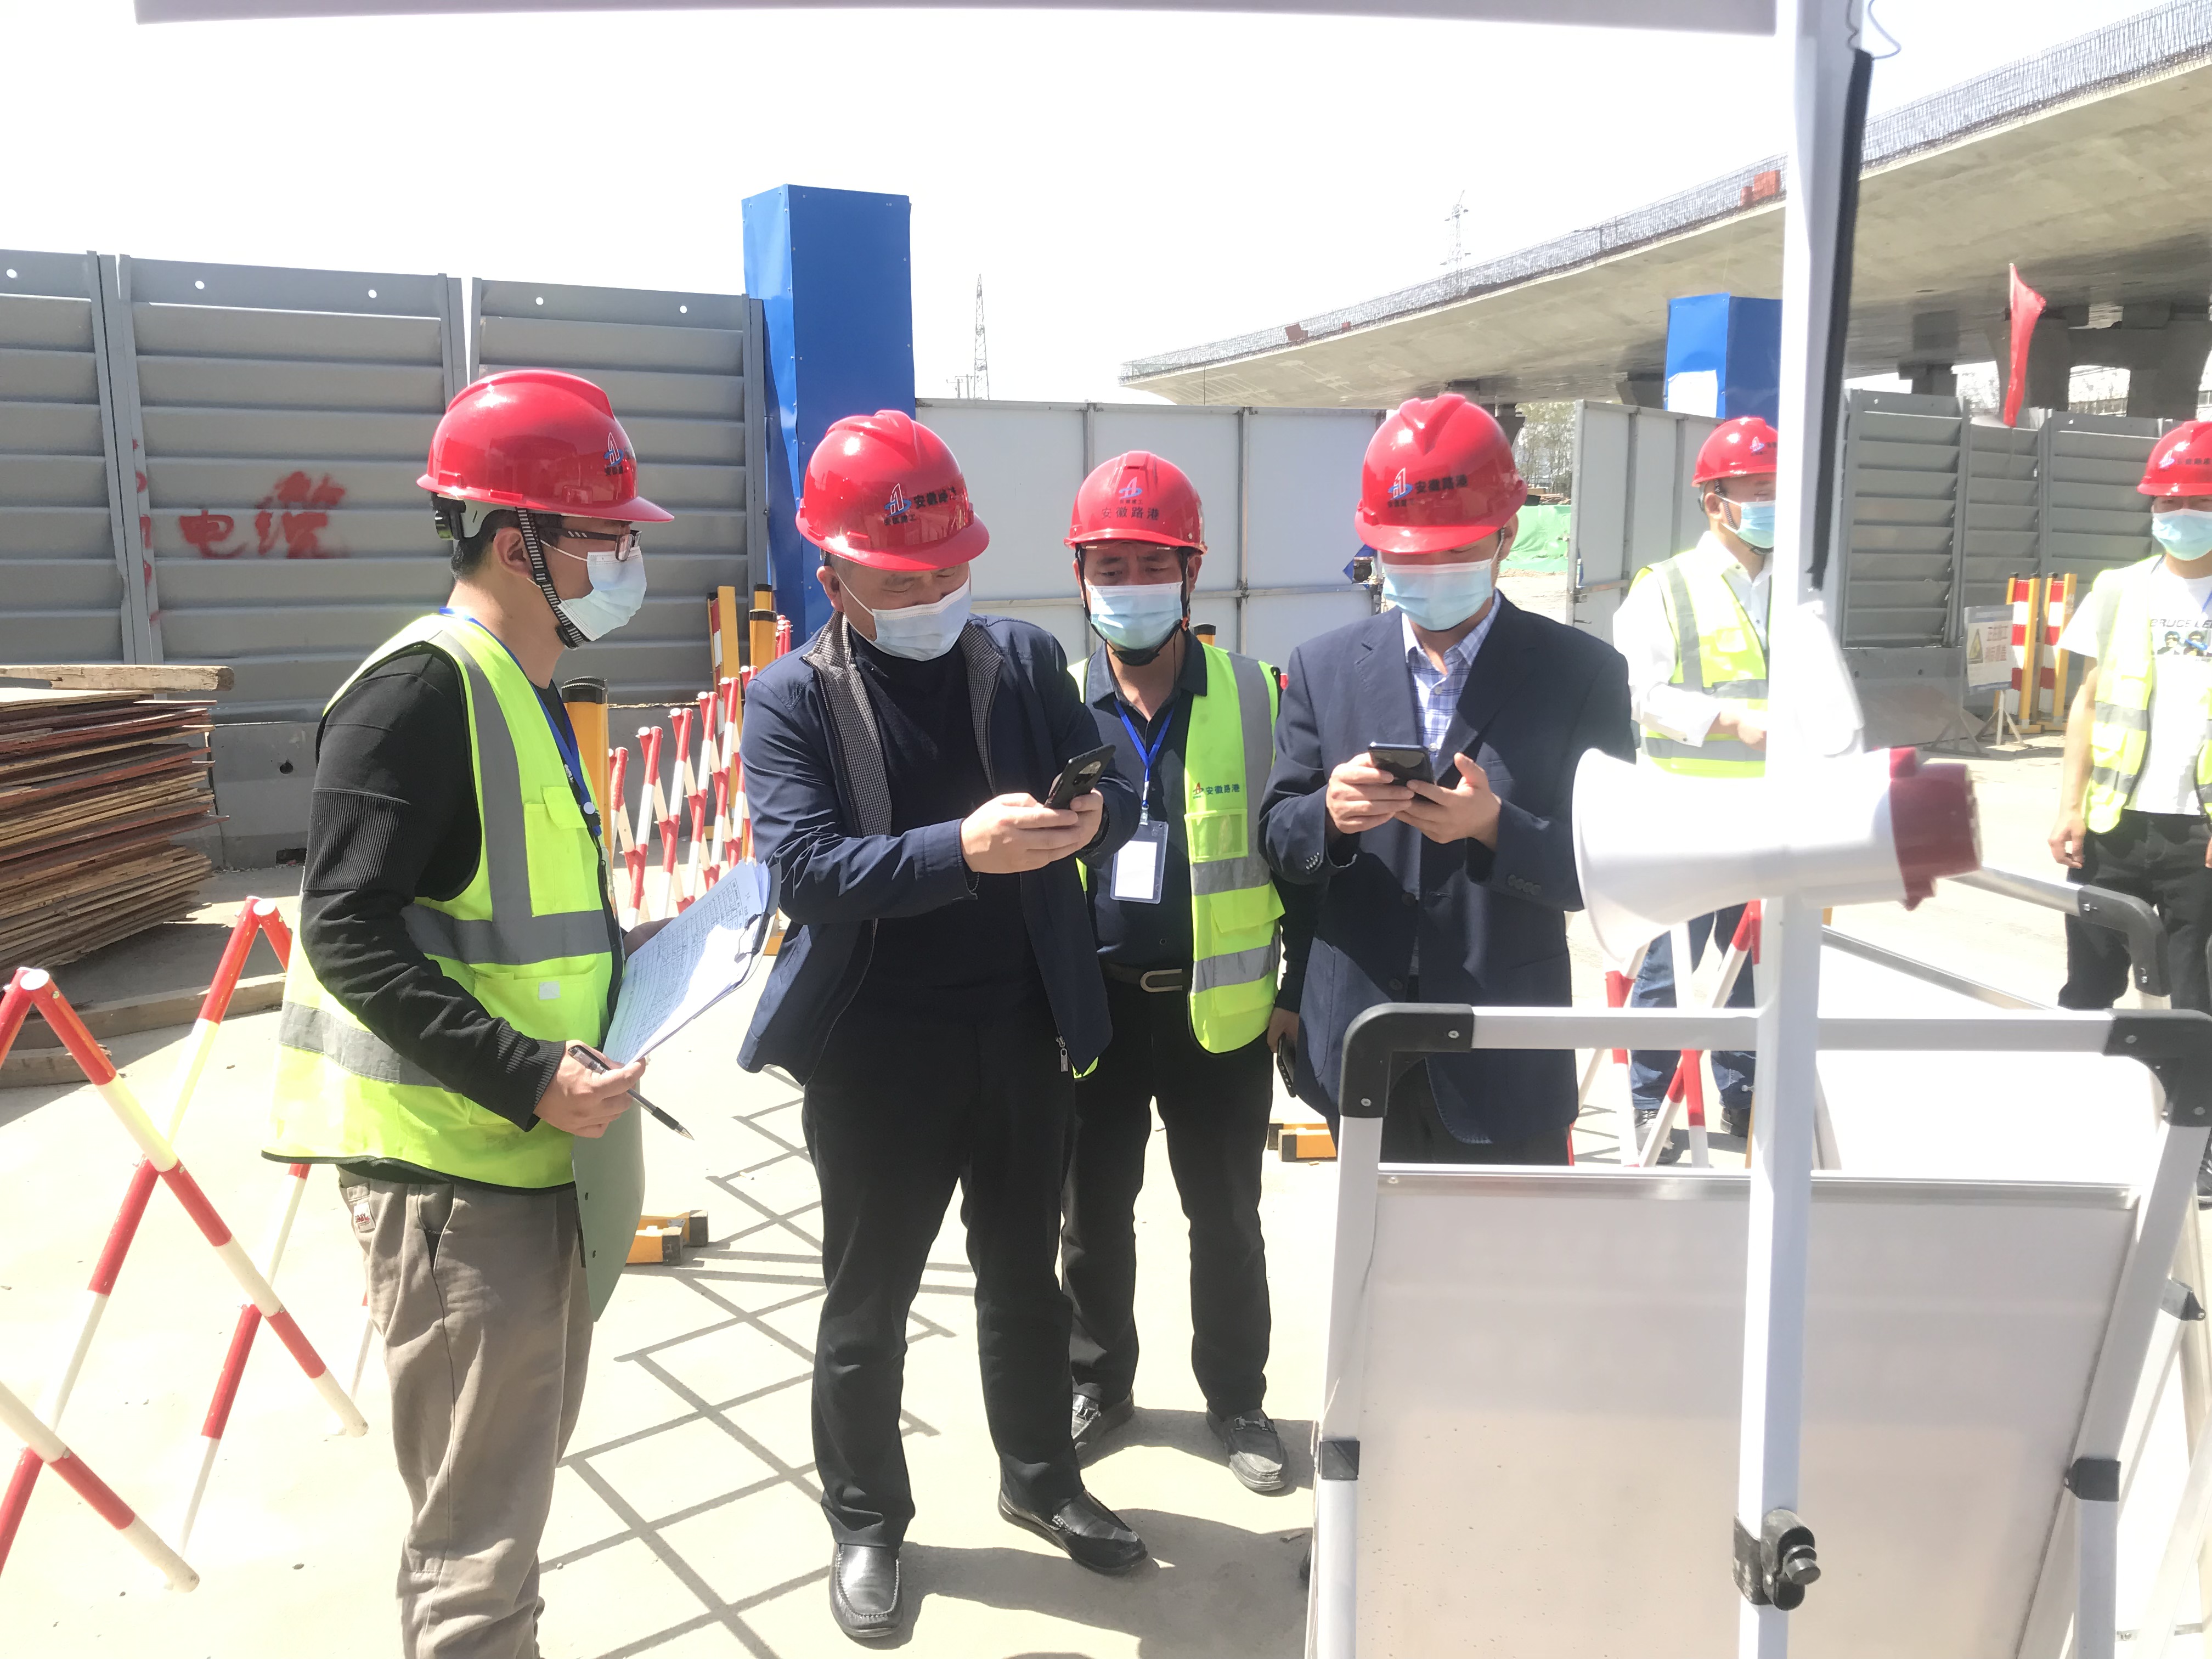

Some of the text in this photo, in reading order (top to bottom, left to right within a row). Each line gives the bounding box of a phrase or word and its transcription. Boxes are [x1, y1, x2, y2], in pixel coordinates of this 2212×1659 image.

[1102, 506, 1159, 520] 安徽路港
[2149, 618, 2192, 628] BRUCE
[1206, 784, 1240, 795] 安徽路港
